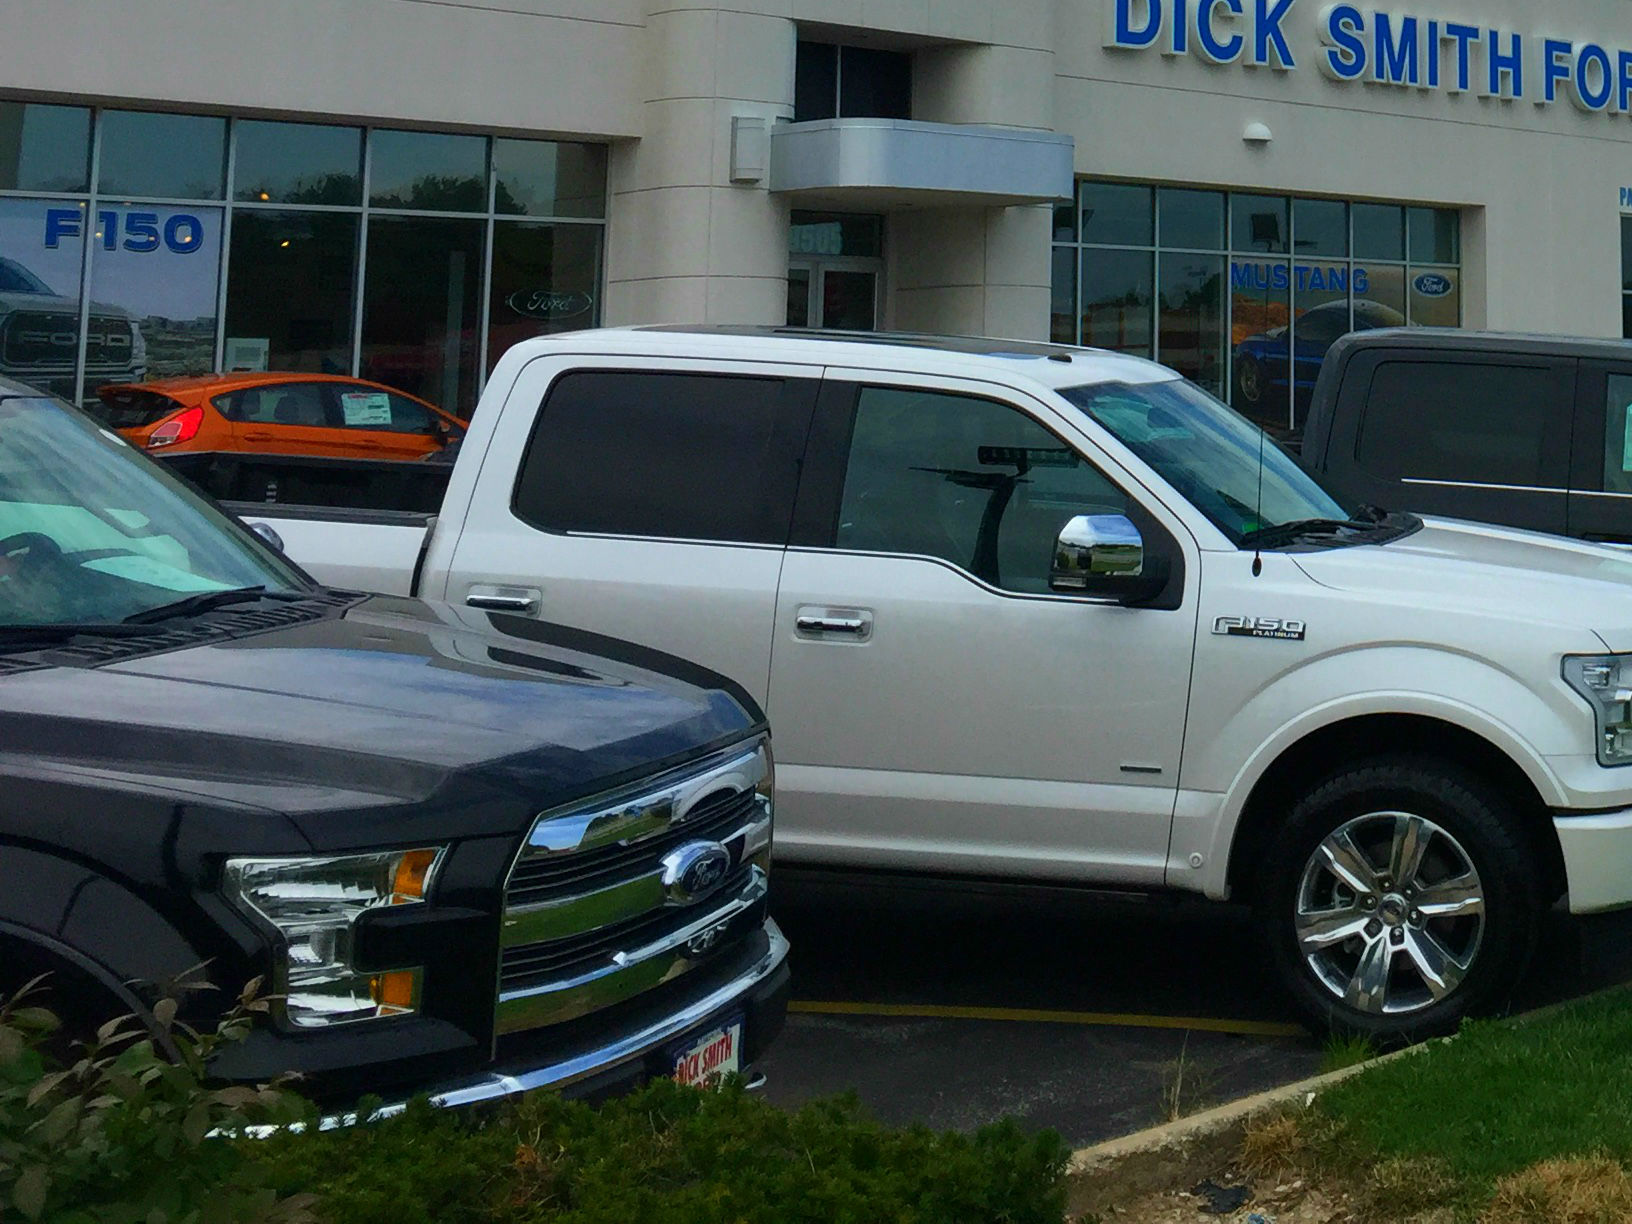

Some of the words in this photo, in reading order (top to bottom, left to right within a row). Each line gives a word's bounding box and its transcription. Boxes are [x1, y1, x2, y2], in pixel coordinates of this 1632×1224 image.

[1326, 3, 1524, 99] SMITH
[45, 209, 204, 254] F150
[1231, 262, 1369, 294] MUSTANG
[527, 290, 575, 311] Ford
[1211, 616, 1306, 635] F150
[1252, 629, 1299, 638] PLATINUM
[702, 1033, 732, 1074] SMITH
